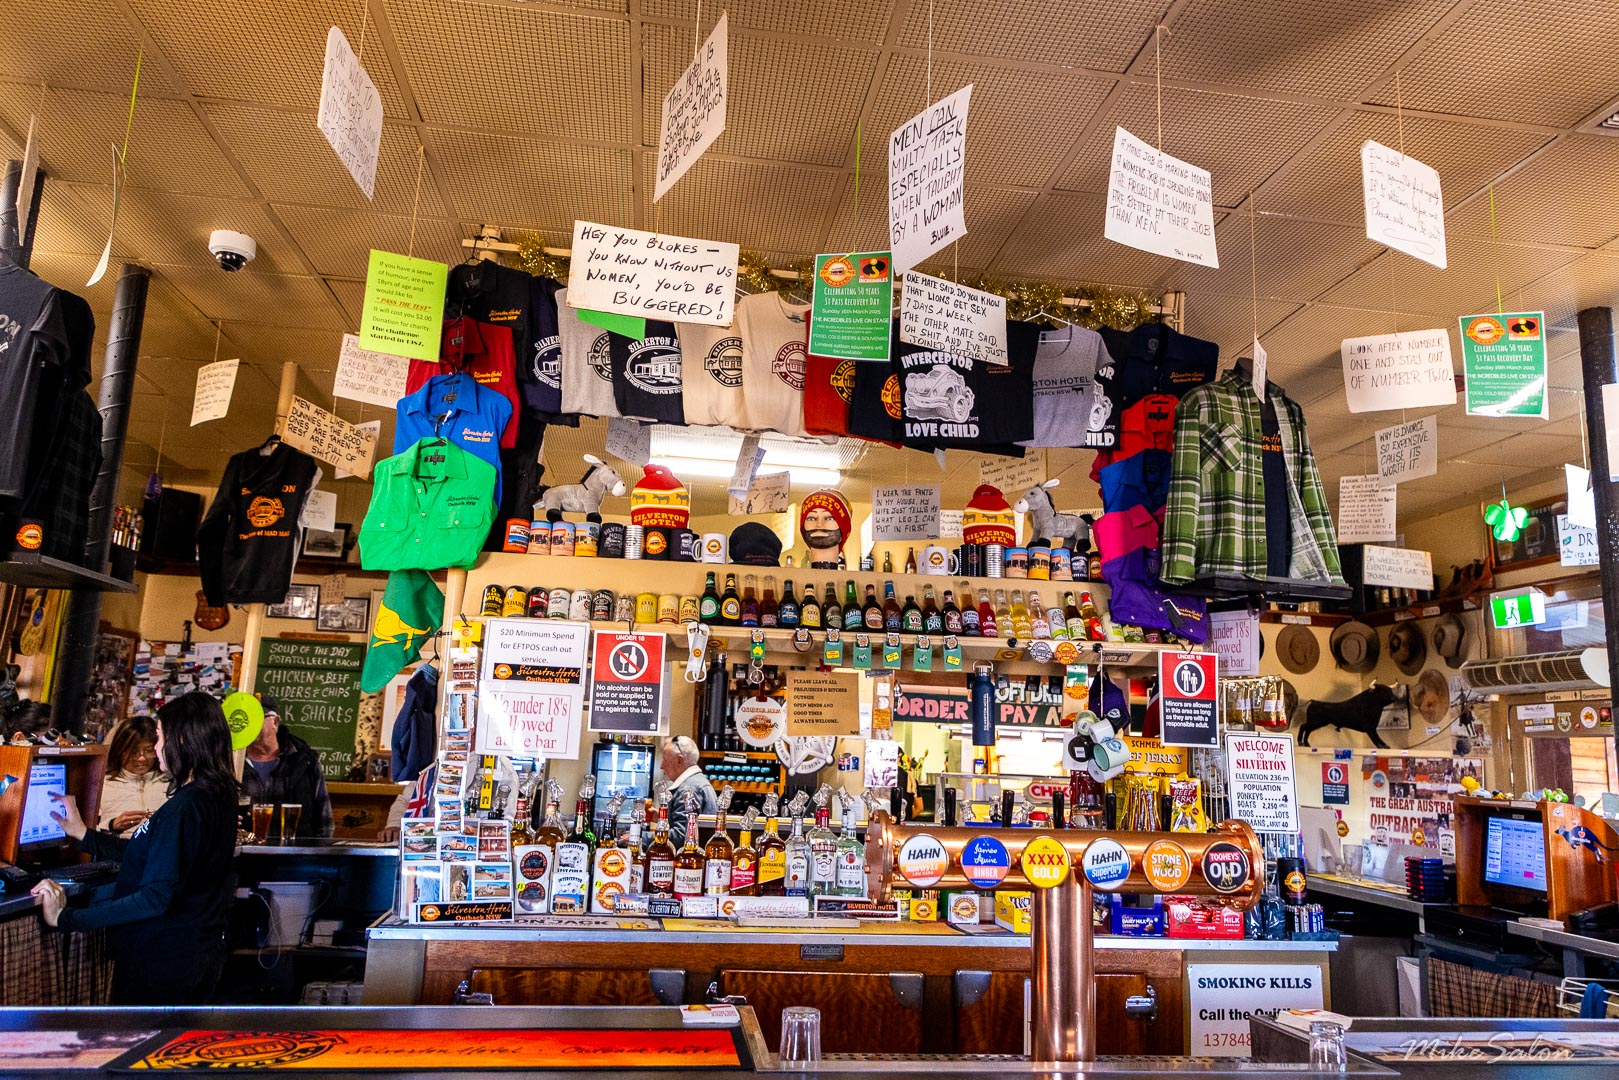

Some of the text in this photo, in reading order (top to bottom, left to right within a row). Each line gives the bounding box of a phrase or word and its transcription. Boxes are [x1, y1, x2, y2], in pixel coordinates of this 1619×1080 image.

[667, 52, 703, 112] This Hotel
[893, 99, 957, 155] MEN CAN
[892, 119, 962, 177] MULTY TASK
[892, 140, 962, 201] ESPECIALLY
[892, 165, 962, 221] WHEN TAUGHT
[892, 185, 962, 245] BY A WOMAN
[1112, 189, 1211, 236] ARE BETTER THEIR JOB
[1110, 206, 1161, 235] THAN MEN.
[581, 227, 698, 254] HEY YOU BLOKES
[587, 248, 732, 277] YOU KNOW WITHOUT US
[586, 269, 723, 295] WOMEN, YOU'D BE
[858, 287, 864, 295] 50
[906, 285, 986, 317] THAT LIONS GET SEX
[906, 298, 976, 324] 7 DAYS A WEEK.
[903, 312, 974, 339] THE OTHER MATE
[628, 336, 670, 353] SILVERTON
[1350, 337, 1444, 355] LOOK AFTER NUMBER
[901, 351, 974, 371] INTERCEPTOR
[1350, 351, 1444, 370] ONE AND STAY OUT
[1060, 377, 1091, 385] HOTEL
[1351, 369, 1452, 389] OF NUMBER TWO.
[294, 397, 371, 442] MEN ARE LIKE PUBLIC
[905, 423, 979, 438] LOVE CHILD
[1380, 421, 1424, 442] WHY IS DIVORCE
[344, 433, 361, 445] GOOD
[1381, 431, 1429, 454] SO EXPENSIVE
[1381, 446, 1421, 465] CAUSE ITS
[1382, 462, 1405, 477] WORTH
[876, 489, 879, 497] I
[915, 488, 933, 496] PANTS
[633, 513, 685, 523] SILVERTON
[642, 519, 677, 527] HOTEL
[876, 525, 890, 533] PUT
[966, 530, 1015, 541] SILVERTON
[975, 536, 1009, 545] HOTEL
[500, 628, 575, 640] $20 Minimum Spend
[1214, 622, 1250, 638] under 18's
[270, 643, 298, 654] SOUP
[315, 646, 328, 655] THE
[330, 647, 352, 657] DAY
[513, 643, 540, 651] EFTPOS
[263, 670, 349, 684] CHICKEN BEEF
[268, 686, 350, 698] SLIDERS CHIPS
[512, 695, 568, 716] under 18's
[897, 697, 1038, 724] ORDER PAY
[301, 705, 354, 723] SHAKES
[535, 734, 556, 749] bar
[1234, 740, 1285, 754] WELCOME
[1144, 752, 1184, 764] JERKY
[1236, 759, 1286, 770] SILVERTON
[1370, 797, 1386, 807] THE
[1388, 799, 1414, 810] GREAT
[908, 848, 941, 860] HAHN
[1028, 854, 1065, 865] XXXX
[1091, 850, 1122, 865] HAHN
[1151, 854, 1182, 866] STONE
[1210, 852, 1240, 862] TOOHEYS
[973, 869, 999, 878] GINGER
[1033, 867, 1060, 879] GOLD
[1091, 865, 1123, 878] SuperDry
[1152, 867, 1182, 878] WOOD
[1210, 862, 1241, 878] OLD
[1198, 978, 1312, 989] SMOKING KILLS
[1200, 1009, 1250, 1020] Call the
